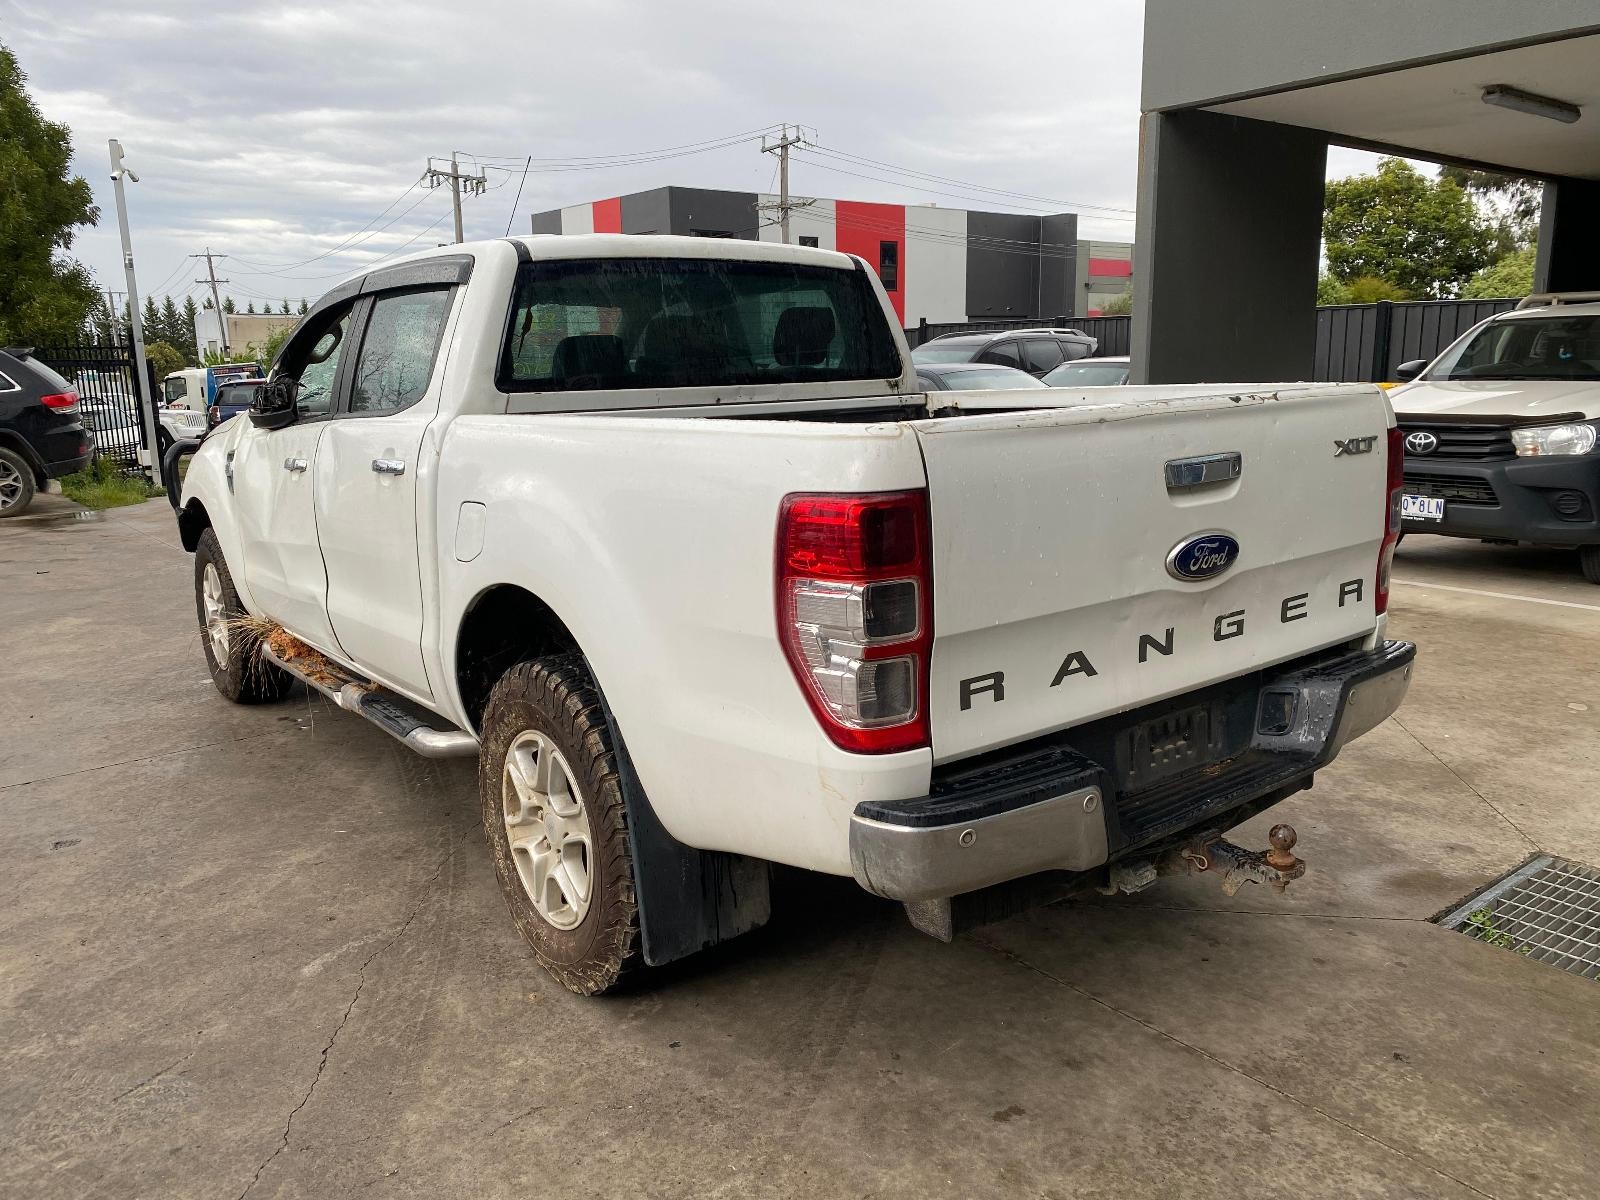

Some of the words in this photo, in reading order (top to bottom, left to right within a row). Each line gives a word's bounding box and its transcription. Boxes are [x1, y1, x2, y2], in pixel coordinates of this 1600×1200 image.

[1334, 435, 1378, 457] XLT
[1190, 542, 1229, 571] Ford
[959, 578, 1364, 711] RANGER
